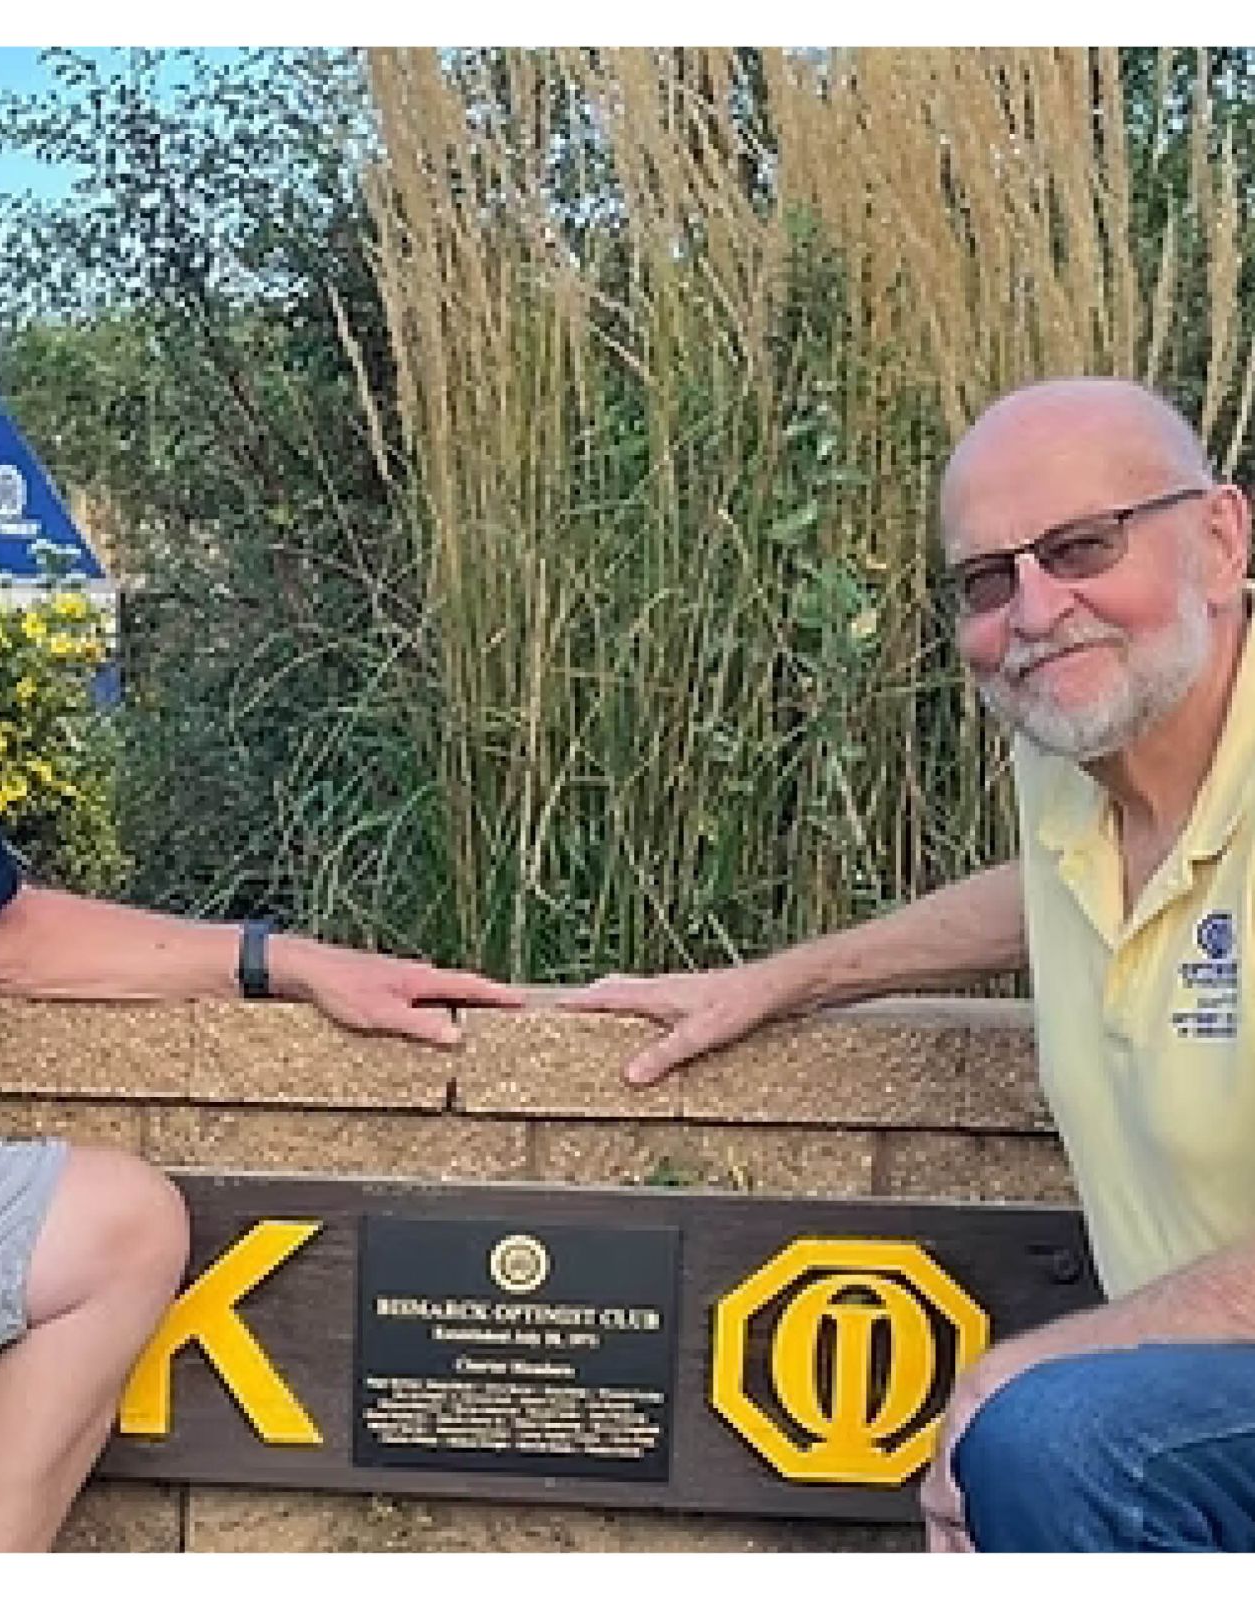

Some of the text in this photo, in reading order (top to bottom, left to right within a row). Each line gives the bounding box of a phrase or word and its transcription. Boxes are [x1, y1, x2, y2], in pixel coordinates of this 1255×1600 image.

[376, 1298, 661, 1330] BISMARCK OPTIMIST CLUB
